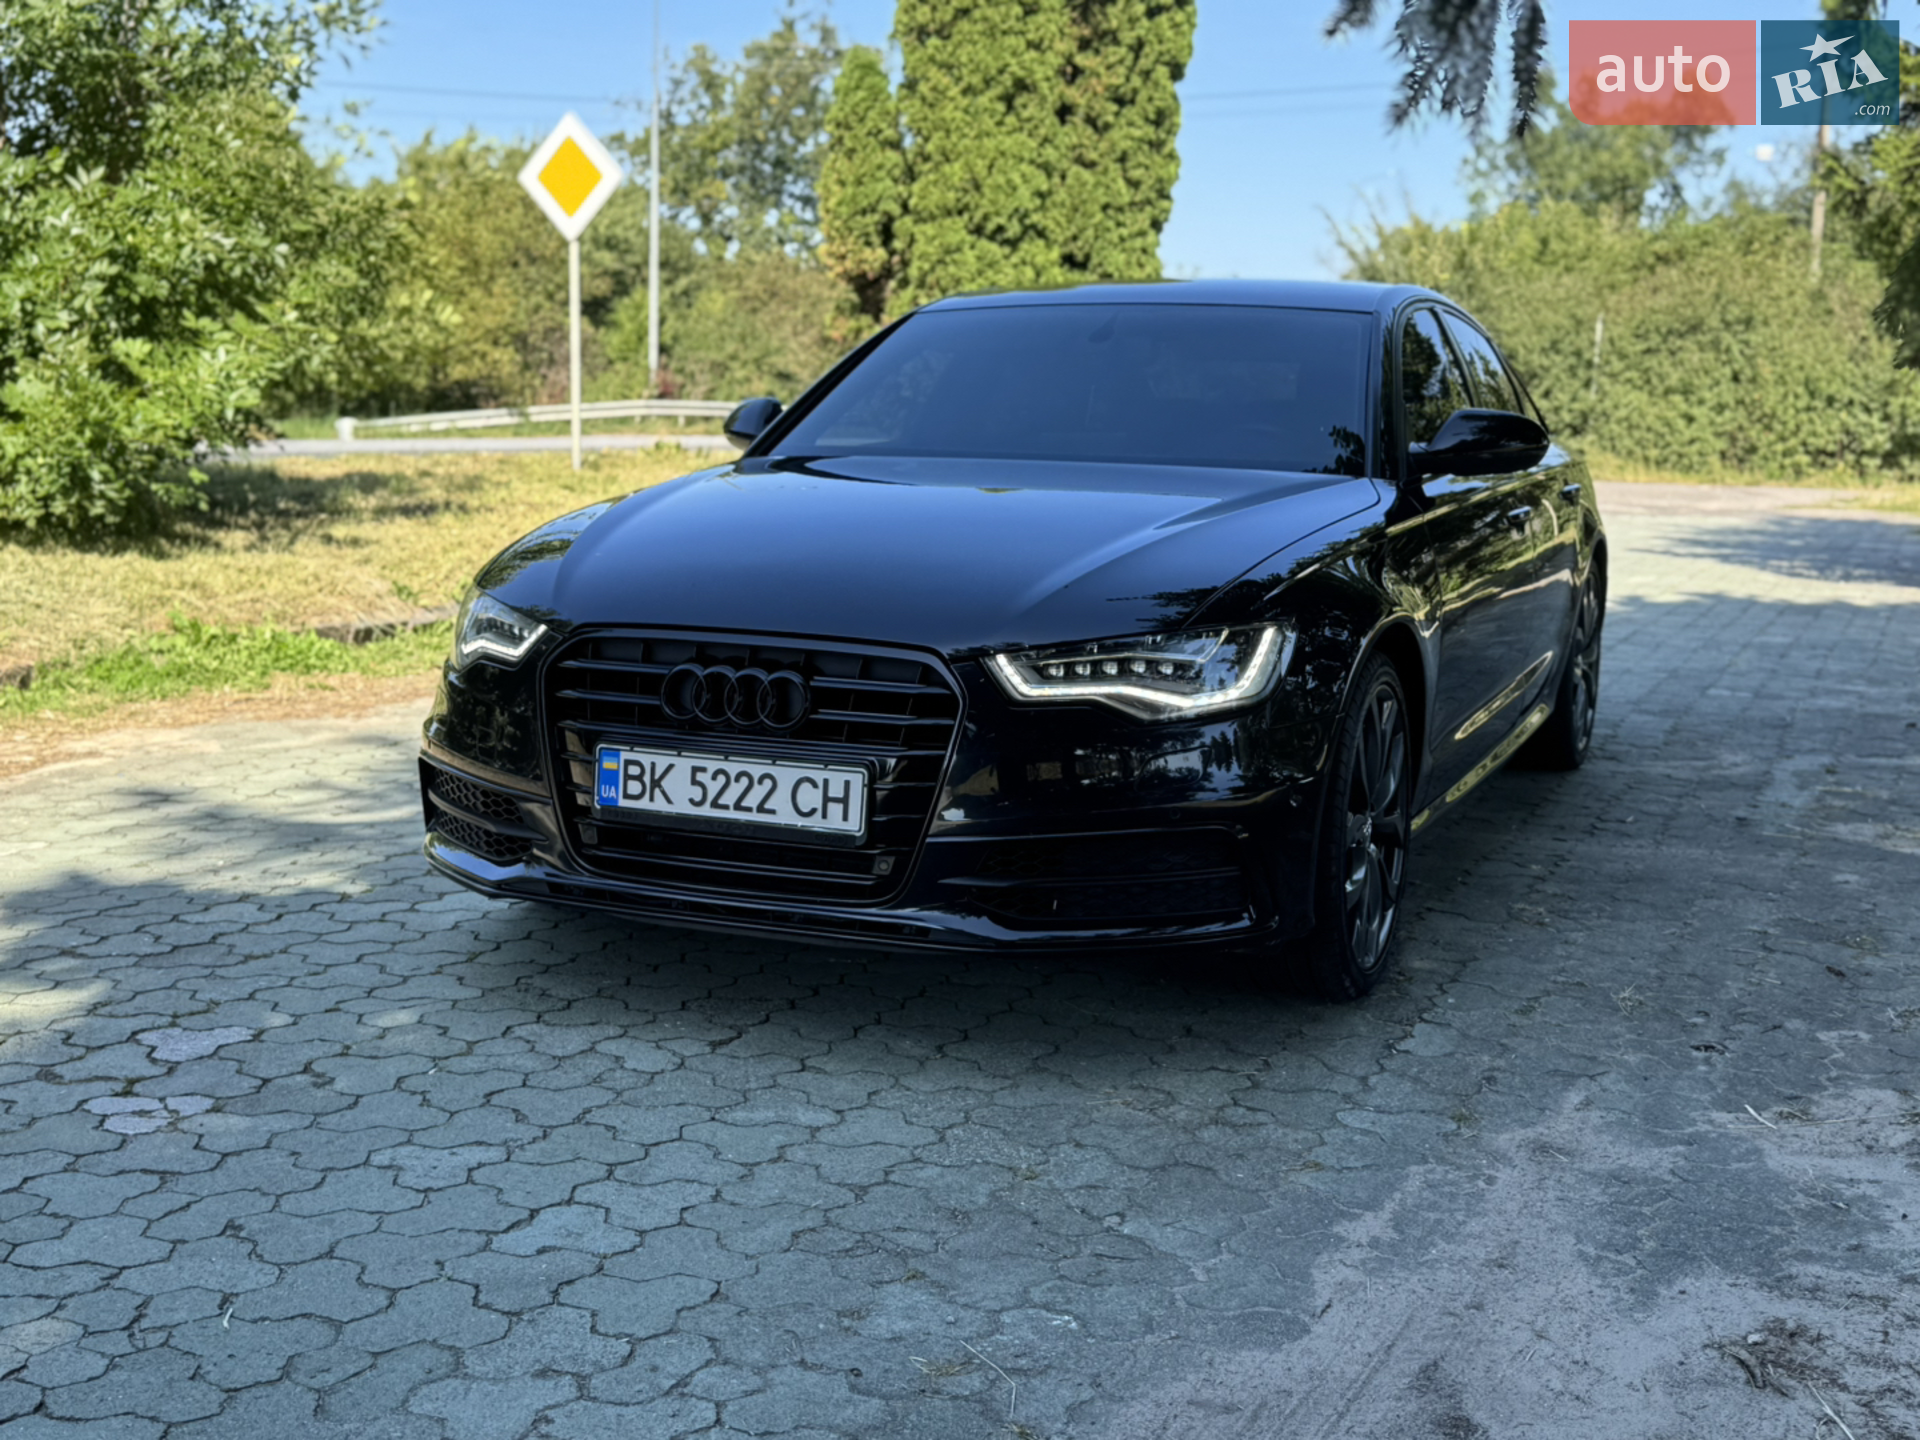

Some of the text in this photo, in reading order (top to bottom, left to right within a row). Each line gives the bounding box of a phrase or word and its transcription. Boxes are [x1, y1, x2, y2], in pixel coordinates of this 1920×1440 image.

[601, 785, 617, 799] UA
[622, 758, 850, 822] BK 5222 CH
